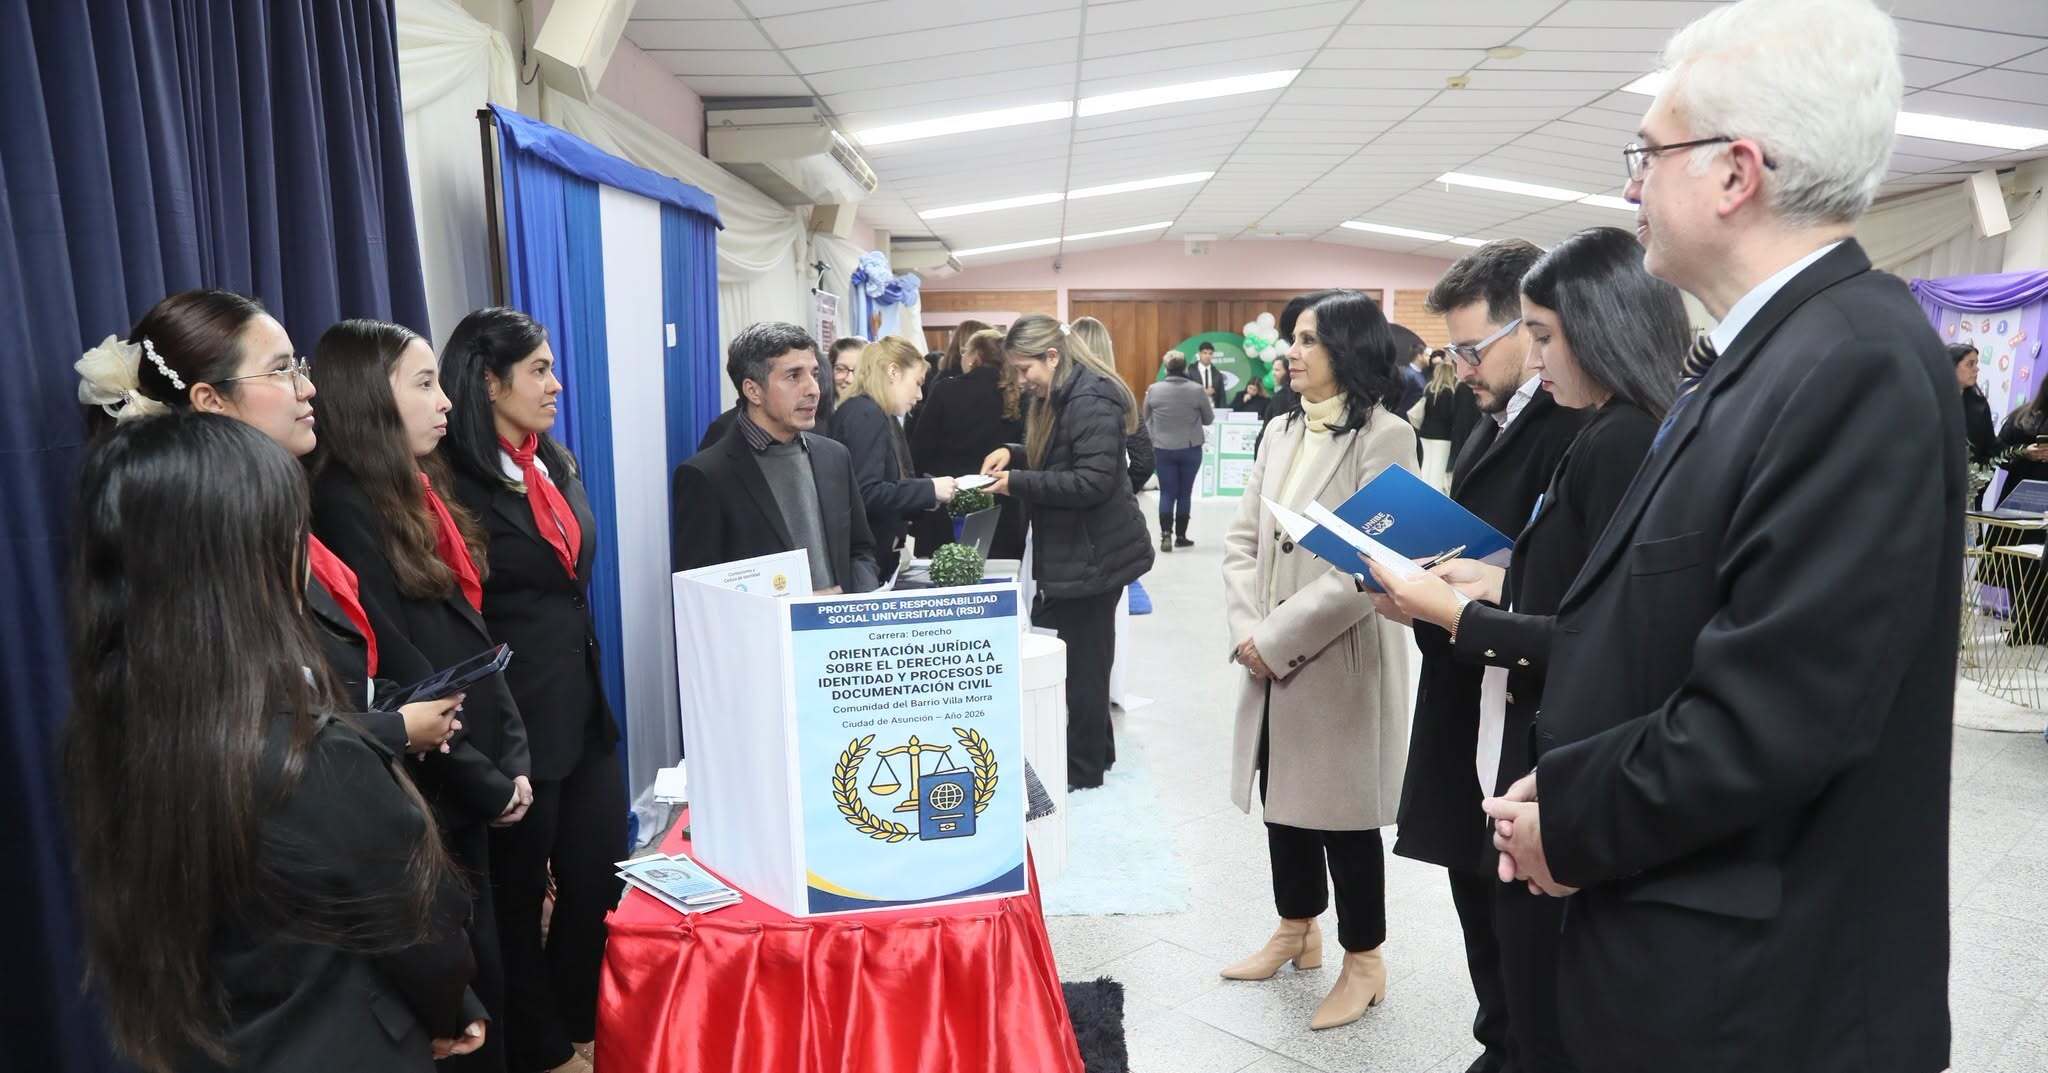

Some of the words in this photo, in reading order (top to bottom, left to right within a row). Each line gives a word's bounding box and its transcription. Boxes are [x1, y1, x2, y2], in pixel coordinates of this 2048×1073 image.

[818, 602, 880, 614] PROYECTO
[882, 601, 897, 610] DE
[900, 595, 998, 609] RESPONSABILIDAD
[828, 614, 870, 624] SOCIAL
[872, 608, 954, 621] UNIVERSITARIA
[956, 606, 985, 617] (RSU)
[868, 632, 908, 640] Carrera:
[911, 628, 952, 637] Derecho
[829, 643, 924, 660] ORIENTACIÓN
[928, 639, 991, 653] JURÍDICA
[826, 661, 873, 674] SOBRE
[877, 660, 893, 670] EL
[897, 655, 961, 669] DERECHO
[965, 654, 974, 664] A
[978, 652, 995, 662] LA
[818, 673, 893, 688] IDENTIDAD
[897, 672, 906, 682] Y
[910, 666, 983, 680] PROCESOS
[986, 664, 1003, 675] DE
[832, 680, 954, 700] DOCUMENTACIÓN
[958, 679, 992, 690] CIVIL
[833, 702, 890, 713] Comunidad
[892, 700, 908, 709] del
[911, 699, 940, 707] Barrio
[942, 696, 963, 704] Villa
[965, 694, 993, 702] Morra
[842, 718, 874, 728] Ciudad
[944, 712, 962, 720] Año
[964, 710, 985, 718] 2026
